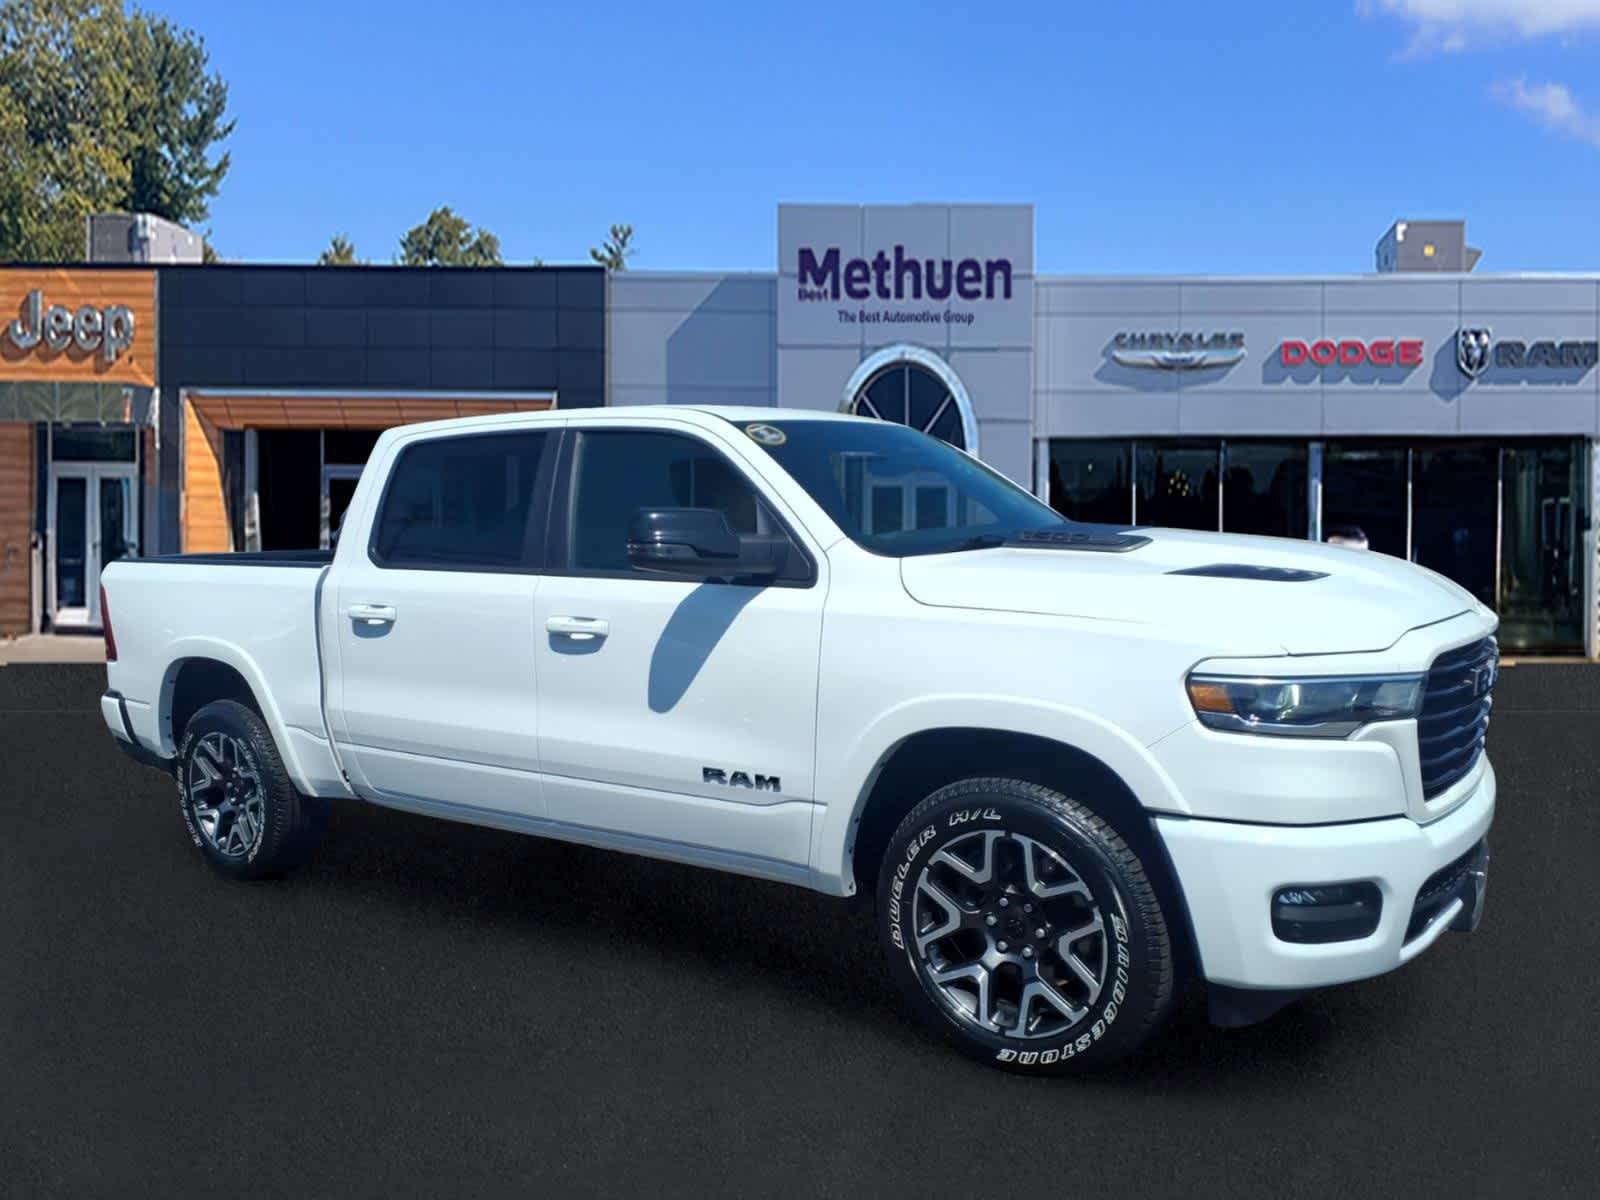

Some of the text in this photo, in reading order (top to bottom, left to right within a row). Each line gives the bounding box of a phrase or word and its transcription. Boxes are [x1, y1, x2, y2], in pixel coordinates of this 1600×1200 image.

[798, 245, 1012, 300] Methuen
[9, 289, 135, 362] Jeep
[838, 310, 975, 327] The Best Automotive Group
[1113, 332, 1245, 350] CHRYSLER
[1282, 339, 1425, 367] DODGE
[1495, 340, 1599, 368] RAM
[702, 766, 782, 792] RAM
[996, 912, 1130, 1065] BRIDGESTONE
